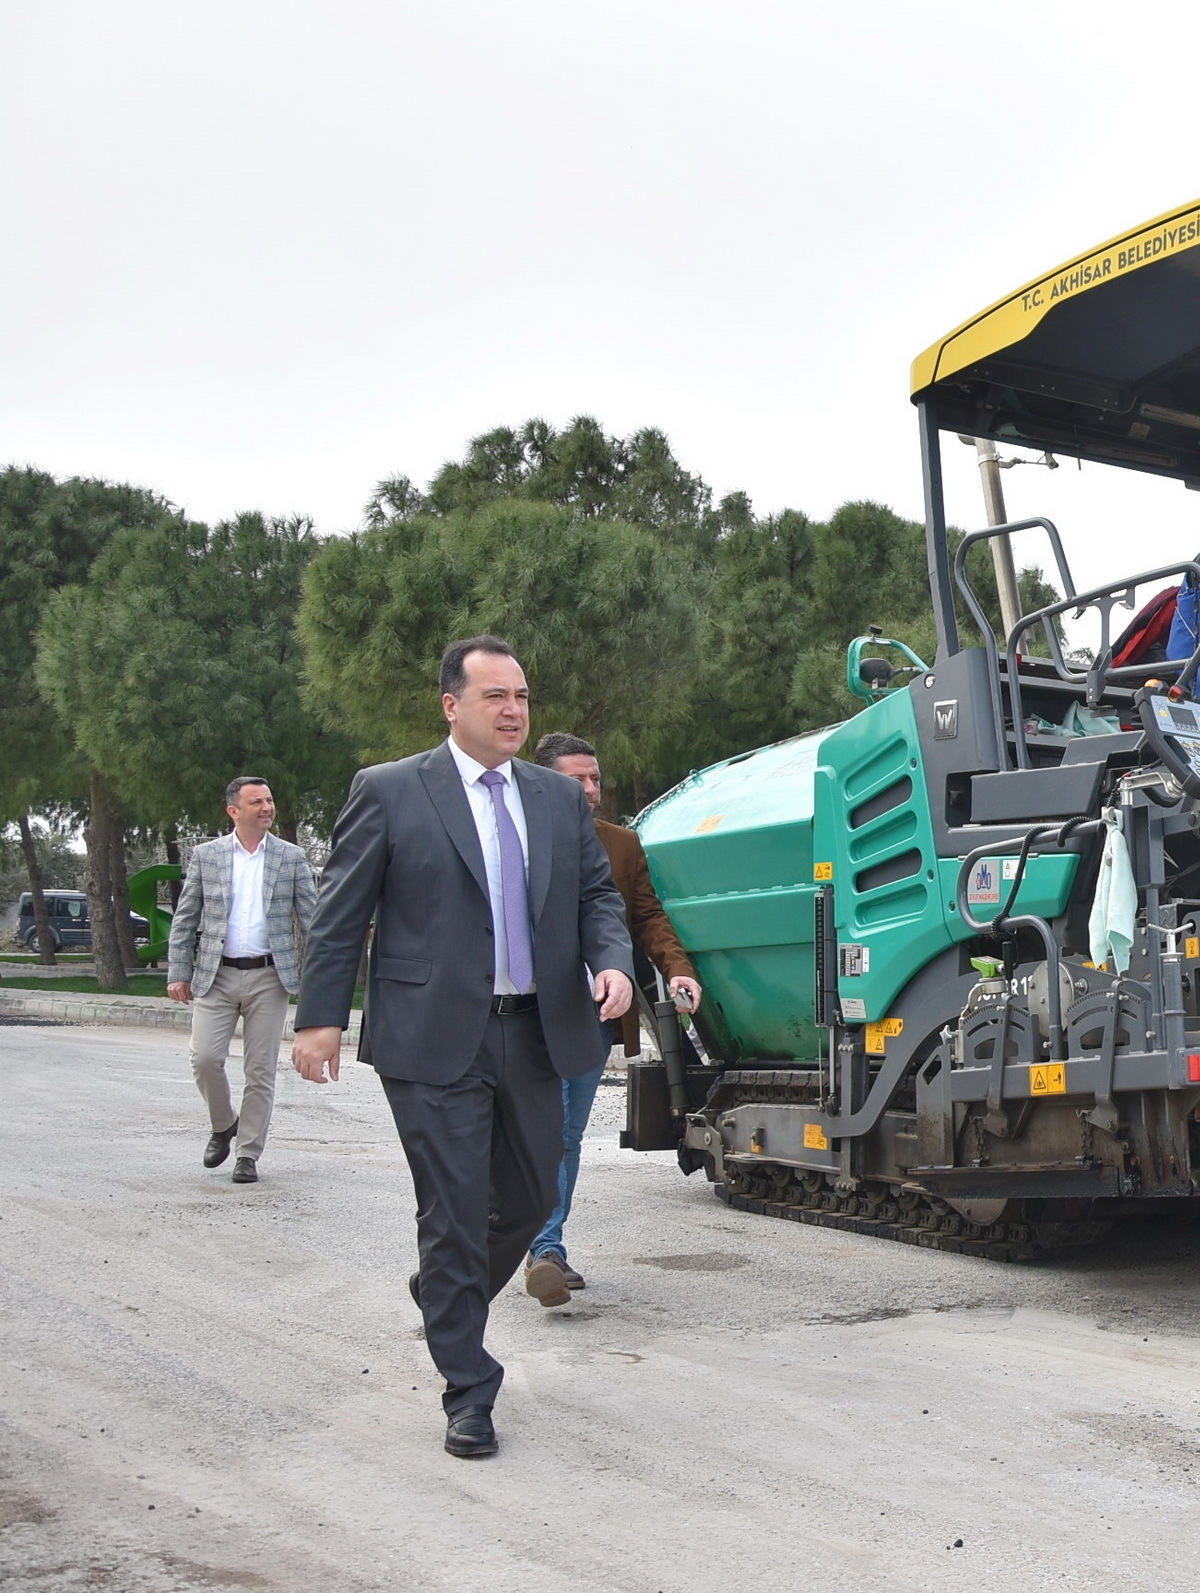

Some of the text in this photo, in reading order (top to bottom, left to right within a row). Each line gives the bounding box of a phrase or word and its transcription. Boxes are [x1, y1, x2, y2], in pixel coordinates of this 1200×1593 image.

[1021, 214, 1200, 312] T.C. AKHİSAR BELEDİYESİ
